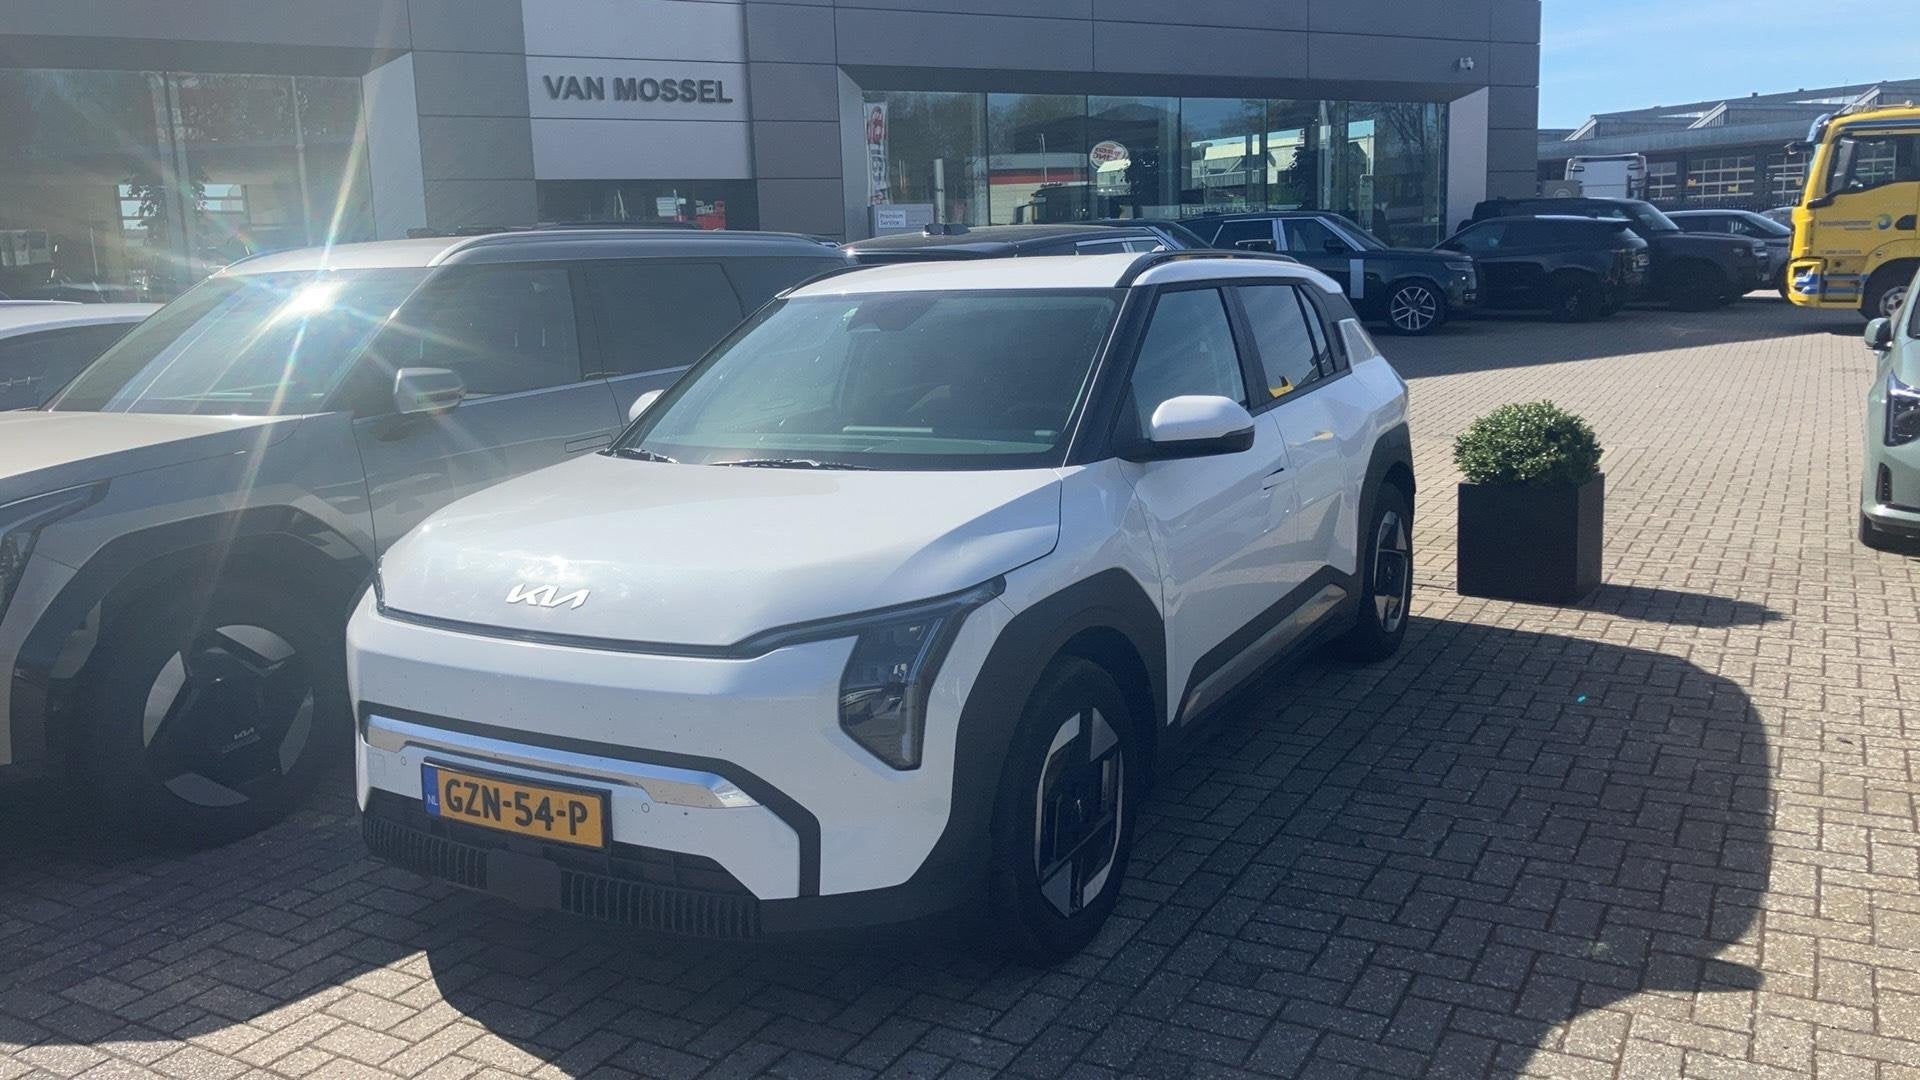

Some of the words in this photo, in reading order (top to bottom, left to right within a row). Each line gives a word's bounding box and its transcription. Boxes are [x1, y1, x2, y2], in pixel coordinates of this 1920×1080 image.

[543, 75, 605, 100] VAN
[613, 77, 734, 103] MOSSEL
[505, 583, 591, 610] KIA
[427, 792, 439, 806] NL
[445, 779, 588, 836] GZN-54-P
